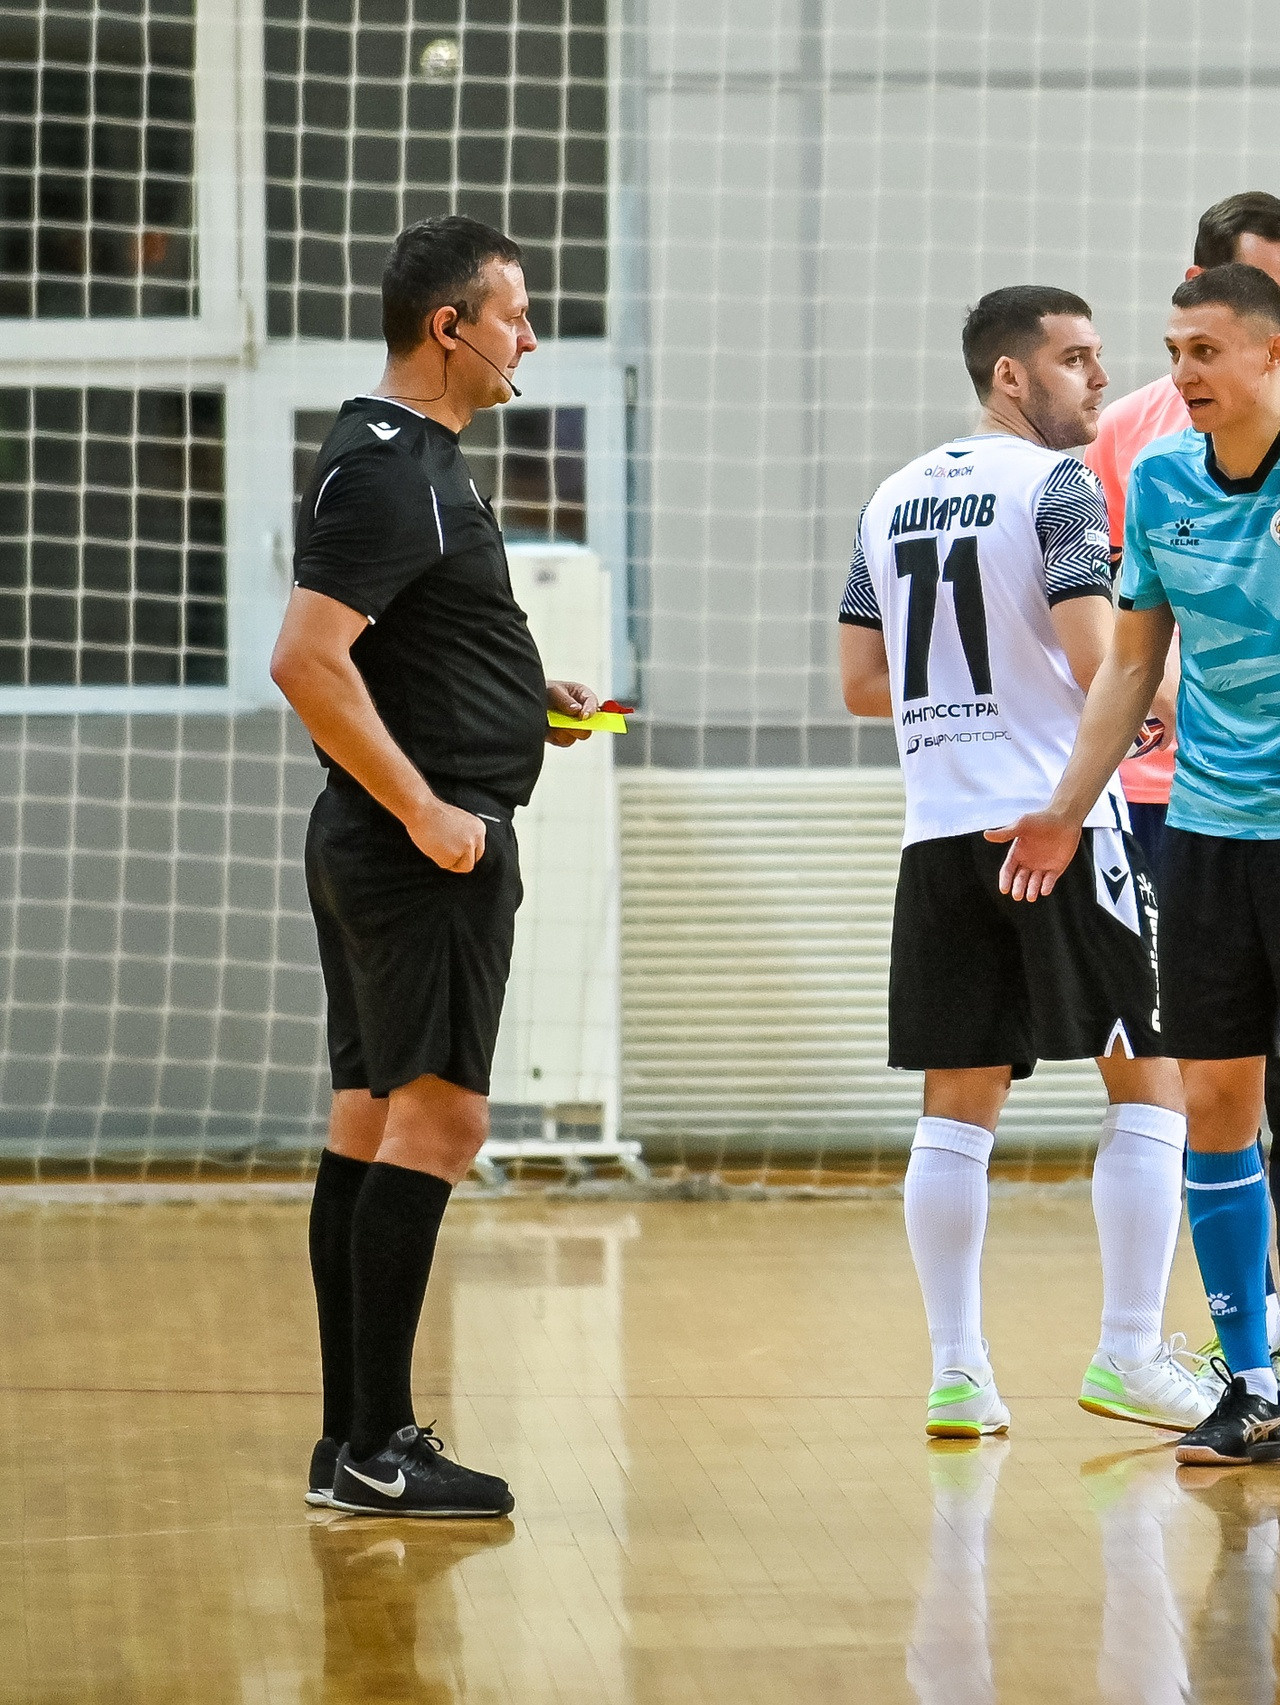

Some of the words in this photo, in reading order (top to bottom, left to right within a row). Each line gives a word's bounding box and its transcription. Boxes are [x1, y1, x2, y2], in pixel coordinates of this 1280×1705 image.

[946, 465, 975, 479] ЮКОН
[888, 493, 997, 540] АШИРОВ
[1170, 538, 1200, 546] KELME
[894, 535, 993, 702] 71
